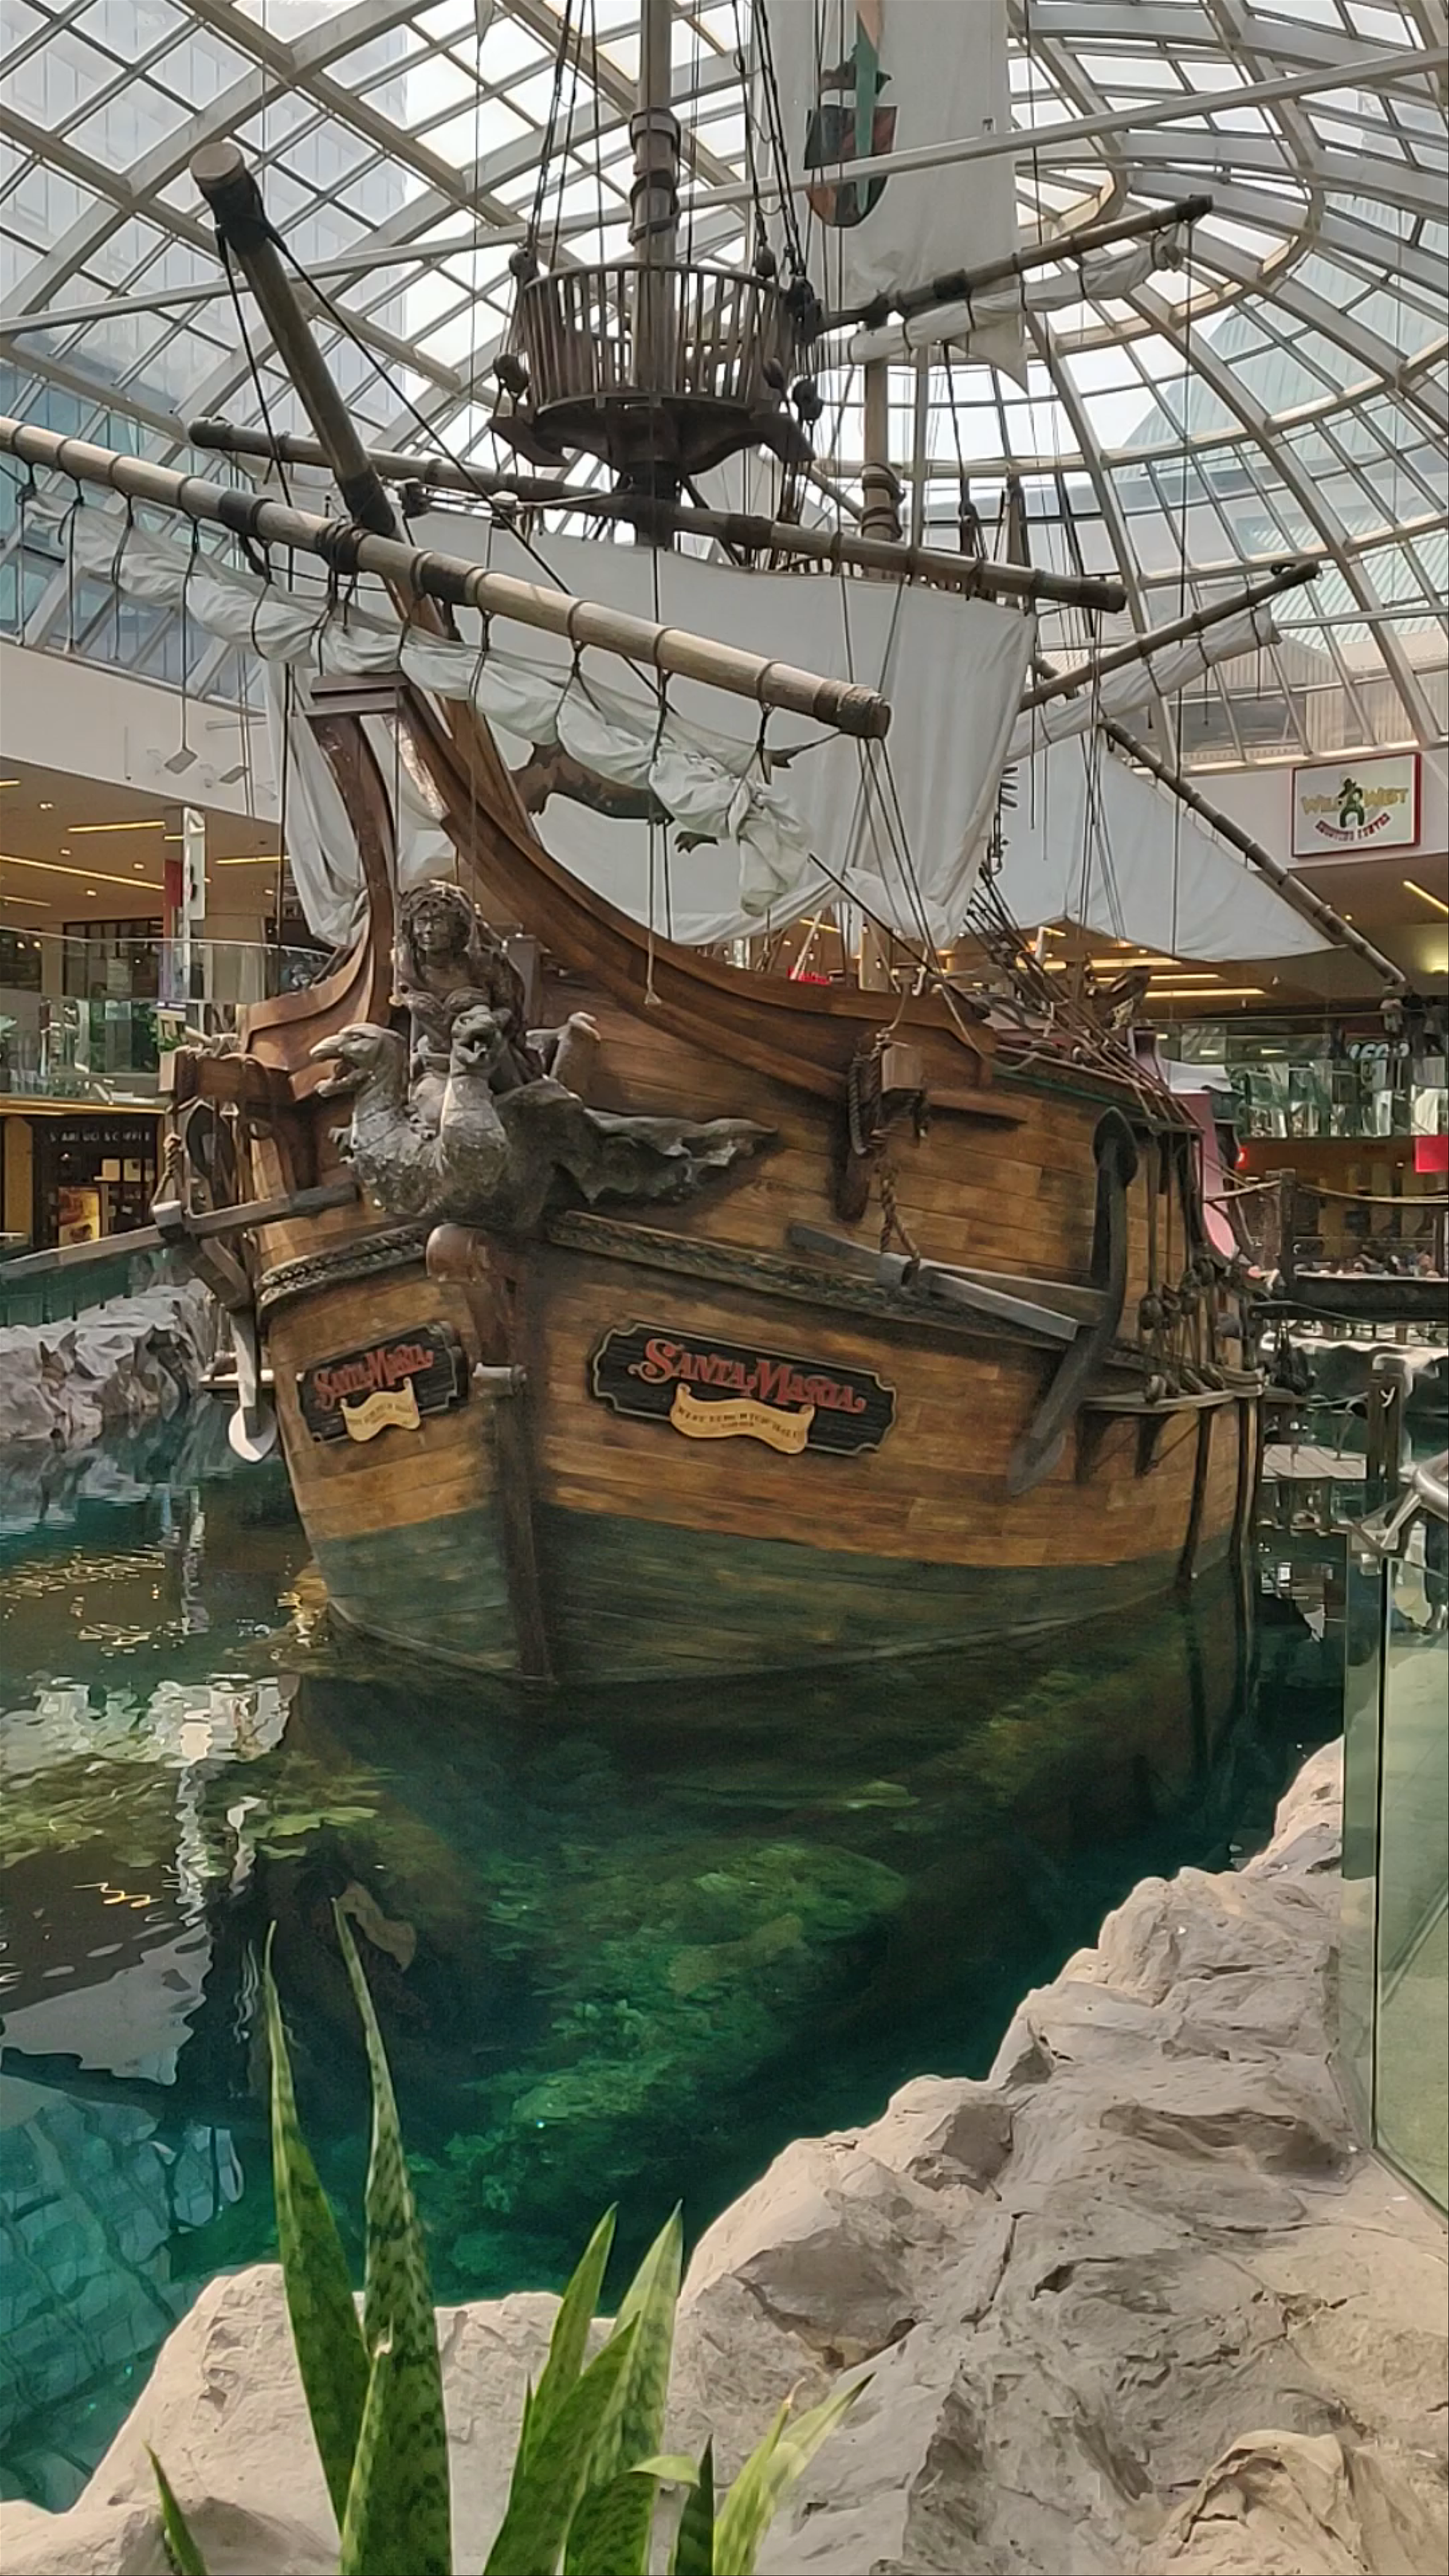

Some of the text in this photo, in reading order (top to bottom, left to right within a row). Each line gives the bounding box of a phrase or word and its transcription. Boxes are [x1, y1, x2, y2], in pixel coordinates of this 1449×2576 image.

[314, 1344, 434, 1410] SANTA MARIA
[628, 1338, 866, 1413] SANTA MARIA
